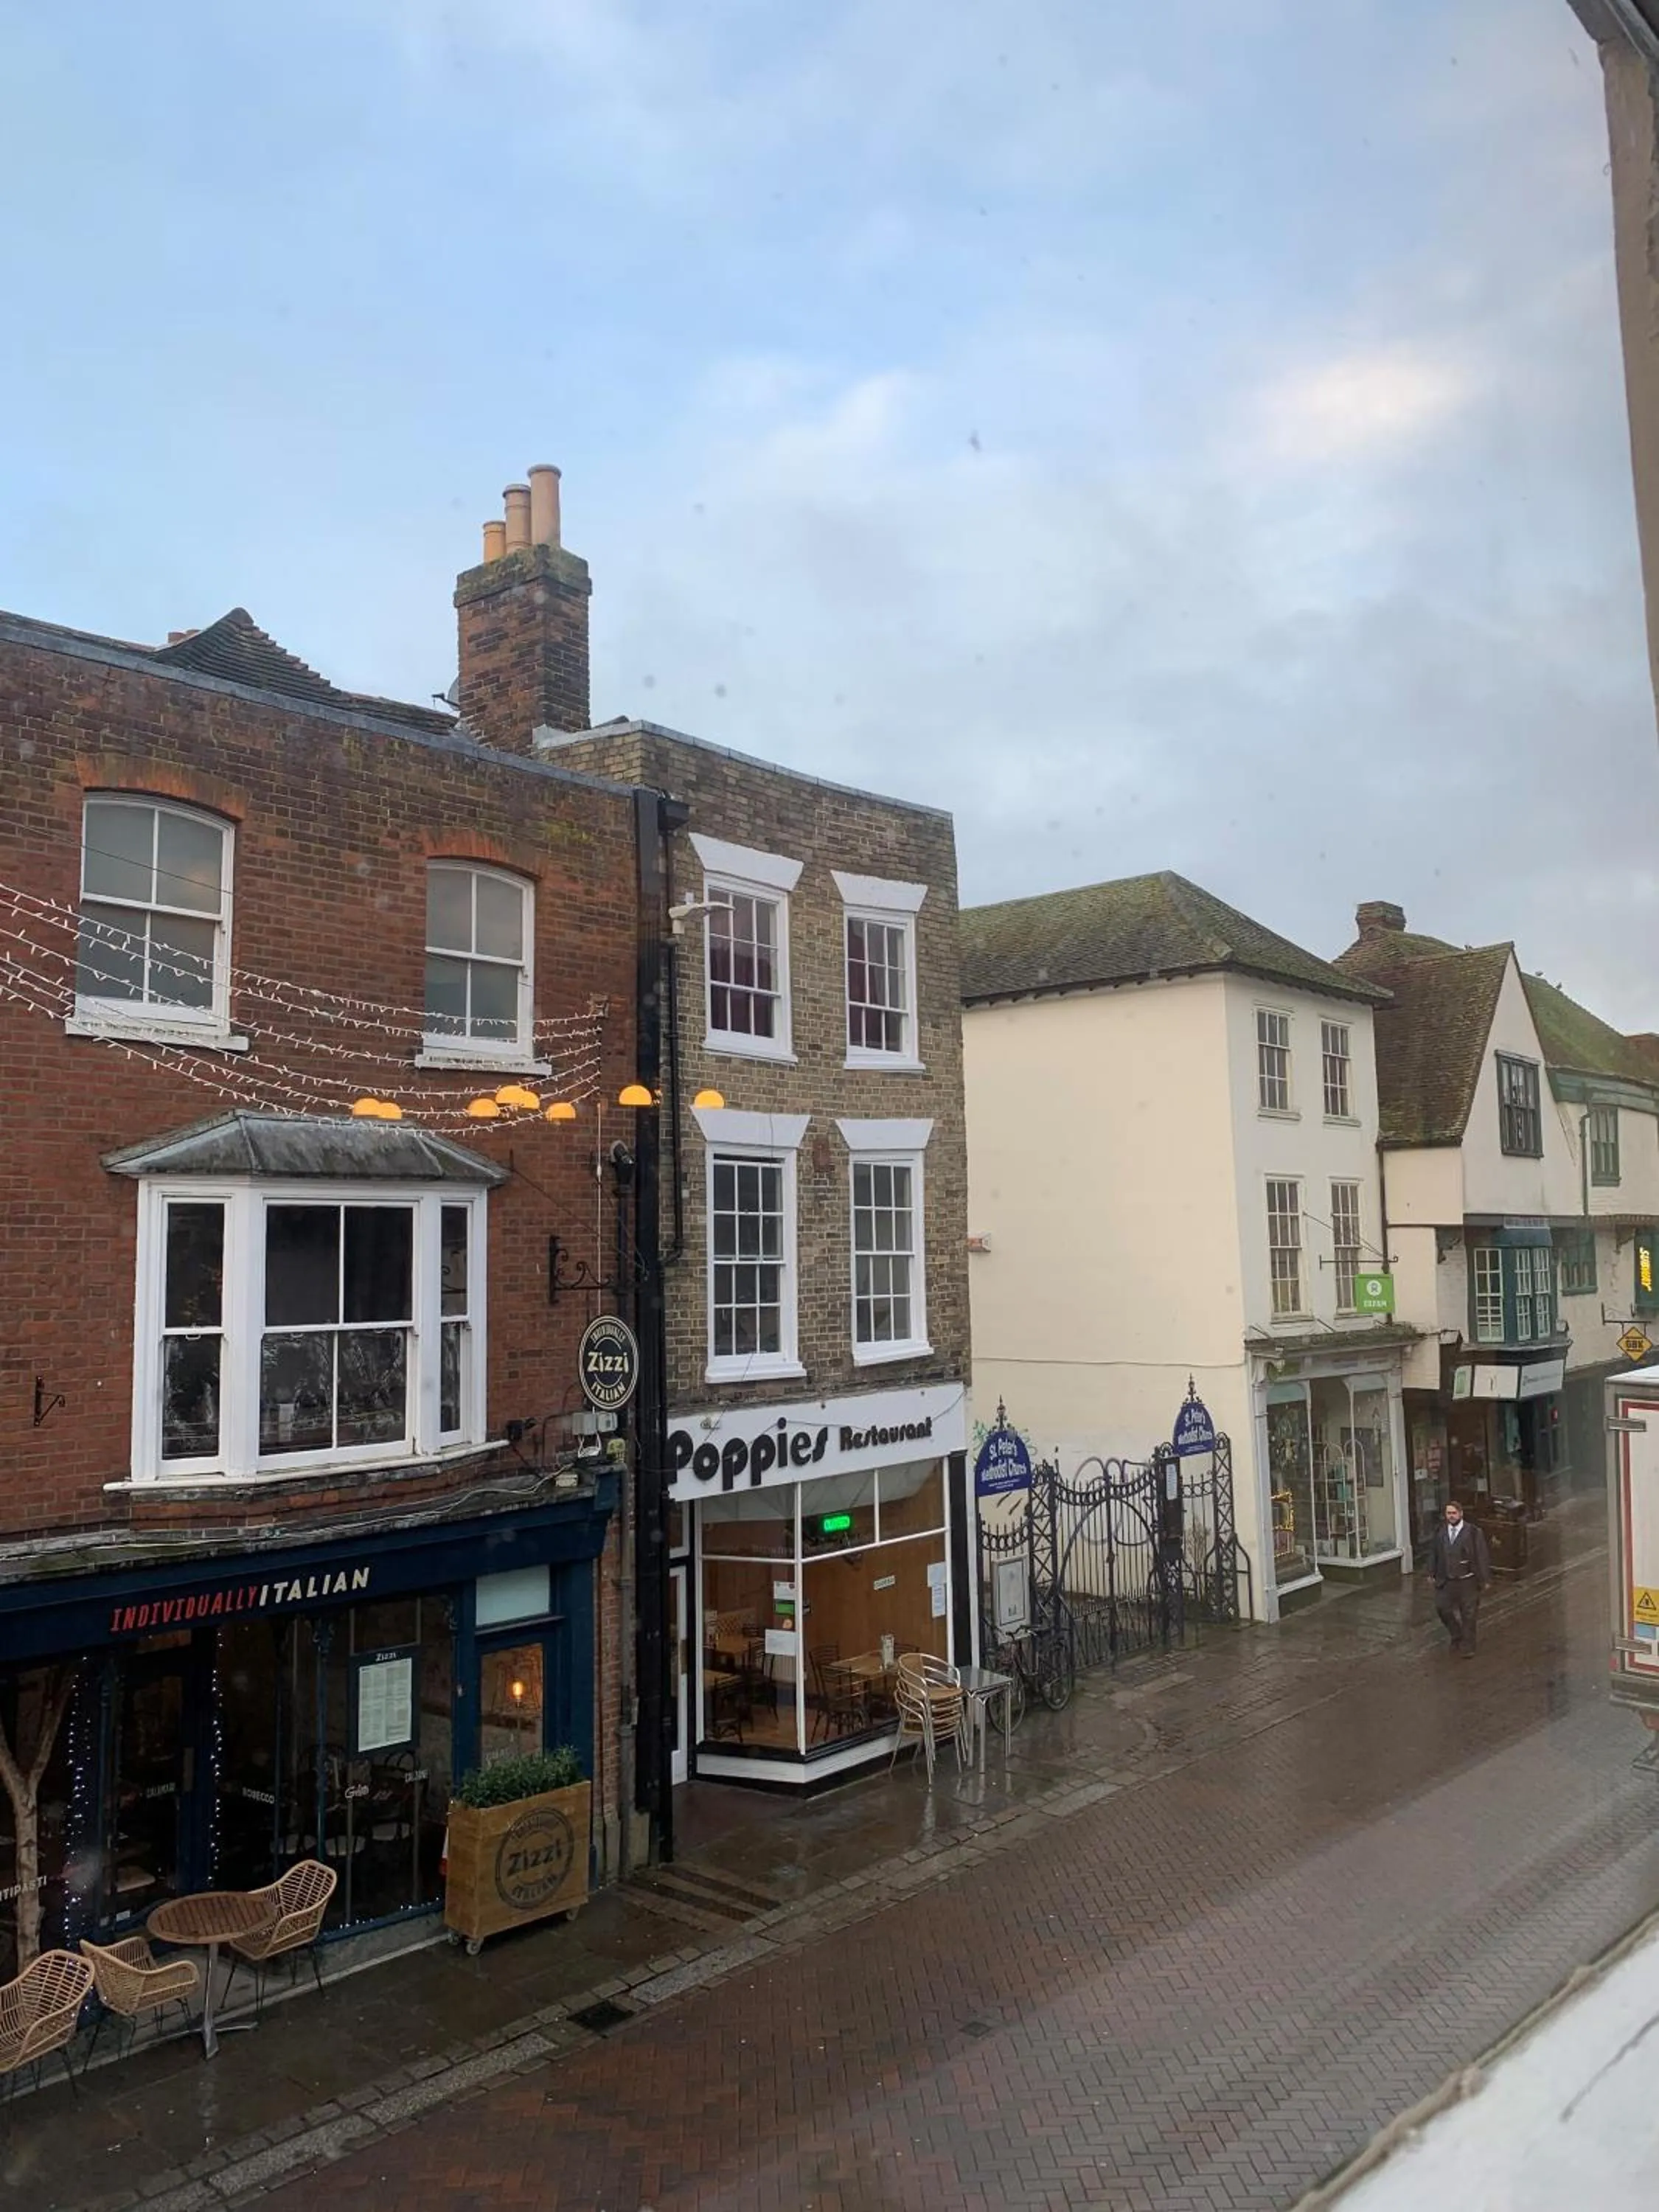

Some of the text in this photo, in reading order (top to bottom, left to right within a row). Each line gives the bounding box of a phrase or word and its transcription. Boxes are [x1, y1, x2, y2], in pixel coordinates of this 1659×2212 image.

[587, 1352, 629, 1373] Zizzi
[591, 1381, 626, 1402] ITALIAN
[667, 1416, 933, 1491] Poppies Restaurant
[998, 1438, 1018, 1458] Peter's
[981, 1458, 1026, 1481] Methodist Church
[110, 1567, 370, 1633] INDIVIDUALLY ITALIAN
[507, 1838, 562, 1877] Zizzi
